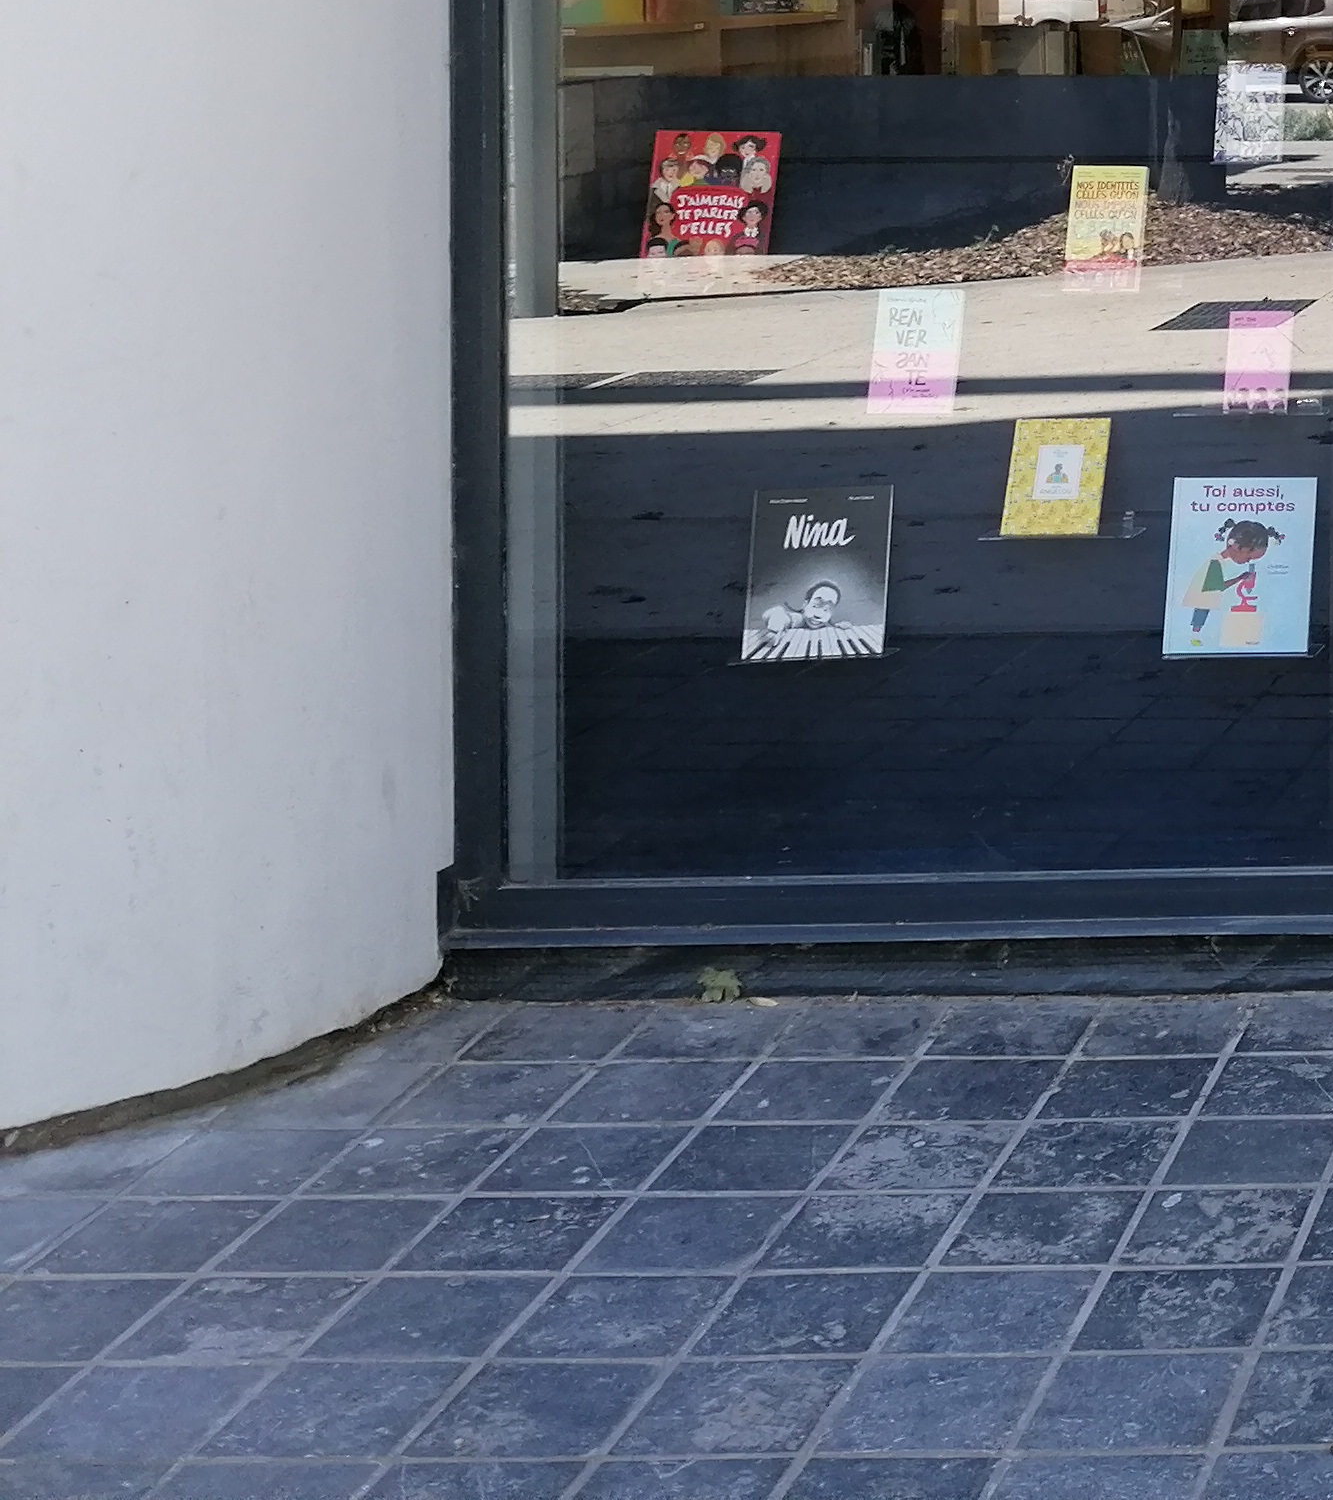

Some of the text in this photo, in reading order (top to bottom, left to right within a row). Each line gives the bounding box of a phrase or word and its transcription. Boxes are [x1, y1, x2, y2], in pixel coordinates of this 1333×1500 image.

[675, 193, 746, 209] J'AIMERAIS
[675, 207, 739, 221] TE PARLER
[679, 221, 734, 239] D'ELLES
[895, 329, 928, 348] VER
[1203, 484, 1285, 500] Toi aussi,
[1190, 501, 1296, 515] tu comptes
[783, 513, 857, 550] Nina
